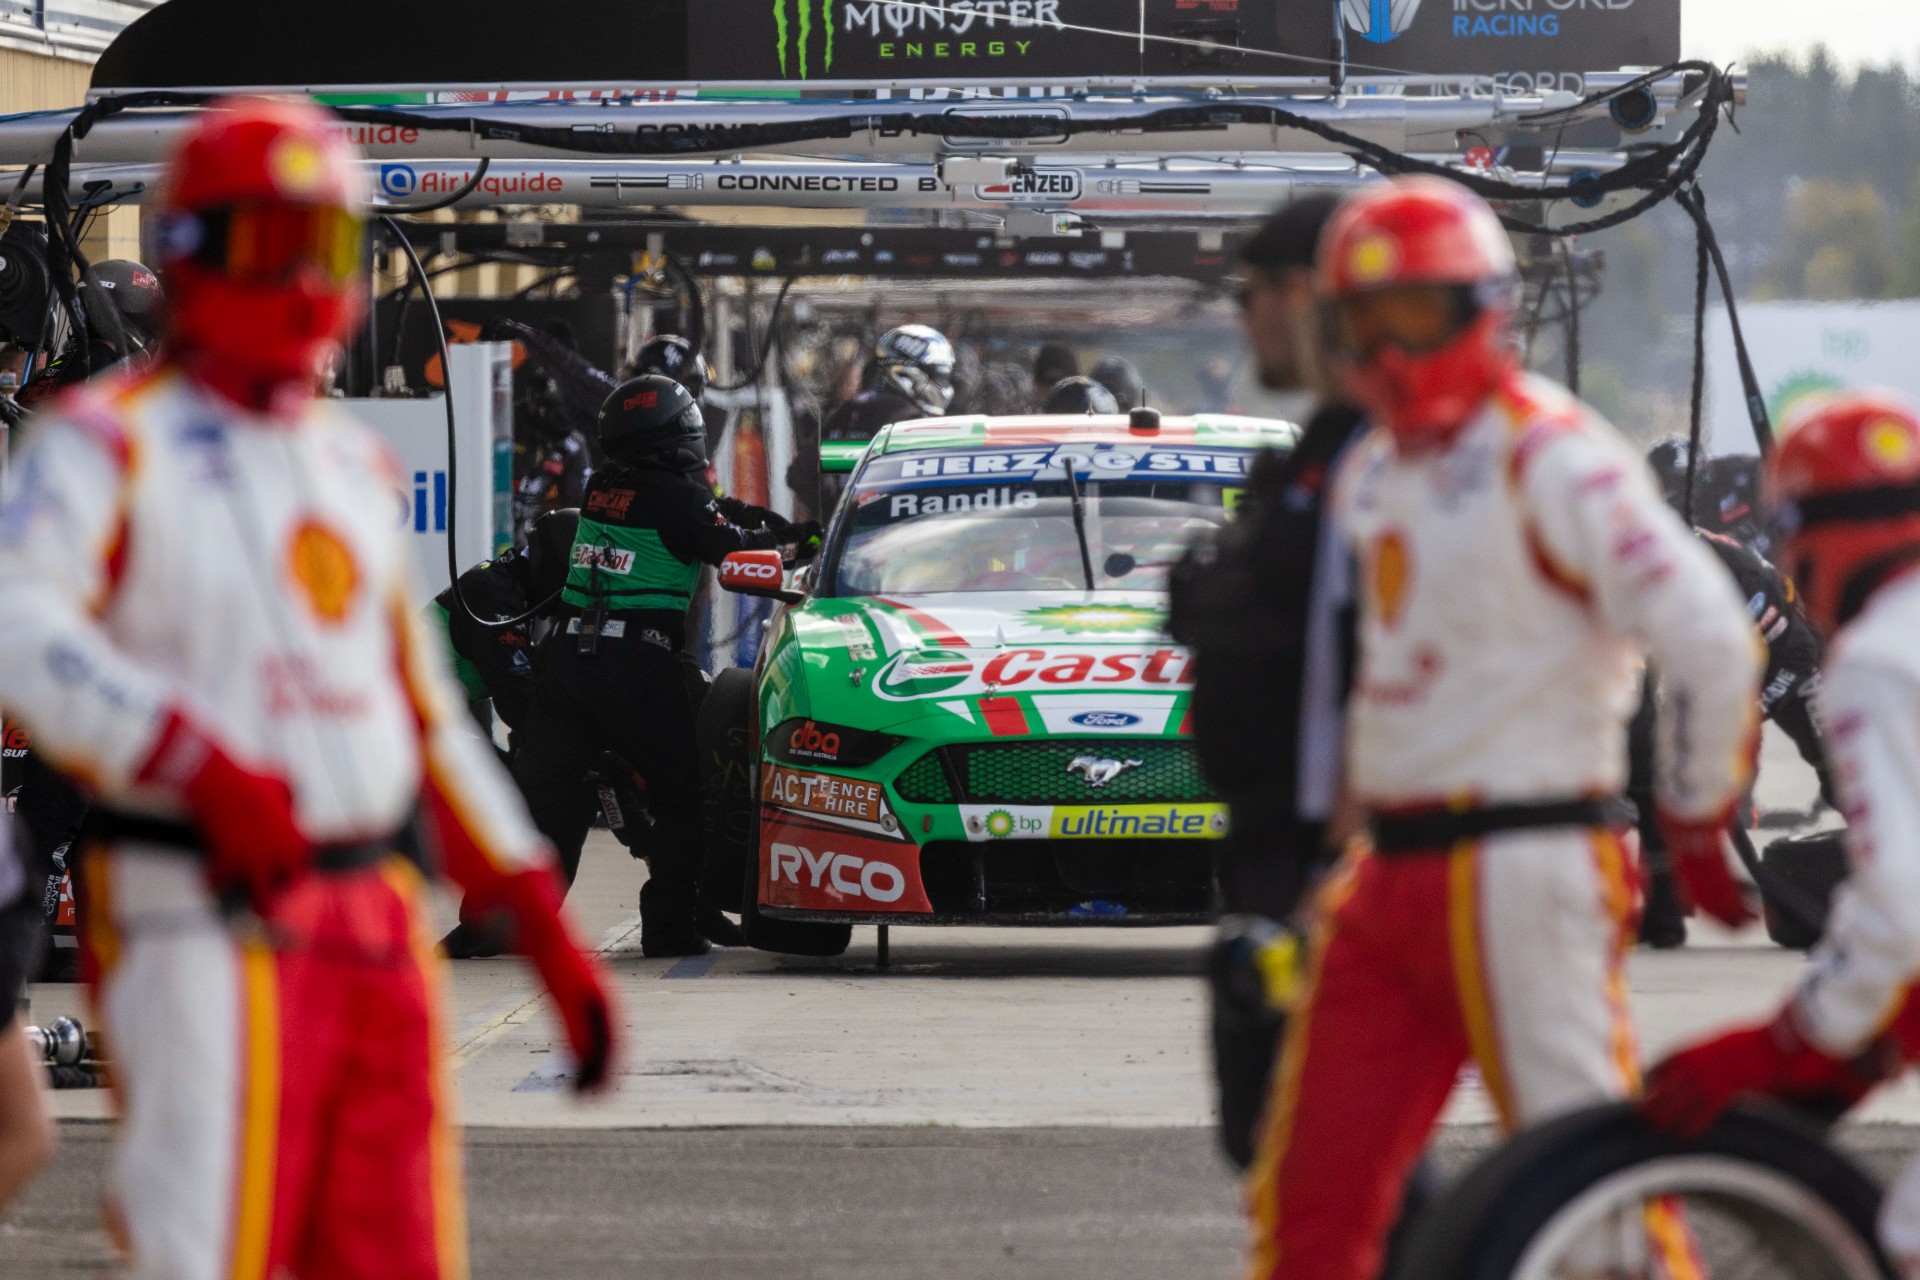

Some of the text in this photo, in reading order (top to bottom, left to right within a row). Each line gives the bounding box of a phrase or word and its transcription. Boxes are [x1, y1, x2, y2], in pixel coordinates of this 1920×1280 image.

[845, 0, 1067, 37] MONSTER
[1453, 14, 1560, 37] RACING
[880, 41, 1031, 57] ENERGY
[421, 172, 459, 193] Air
[717, 174, 898, 192] CONNECTED
[901, 453, 1250, 478] HERZOG STE
[890, 488, 1038, 518] Randle
[722, 562, 777, 579] RYCO
[981, 650, 1197, 686] Cast
[1085, 711, 1131, 727] Ford
[791, 721, 840, 755] dba
[771, 772, 878, 806] ACT FENCE
[824, 796, 869, 816] HIRE
[1020, 809, 1205, 836] bp ultimate
[770, 842, 905, 902] RYCO
